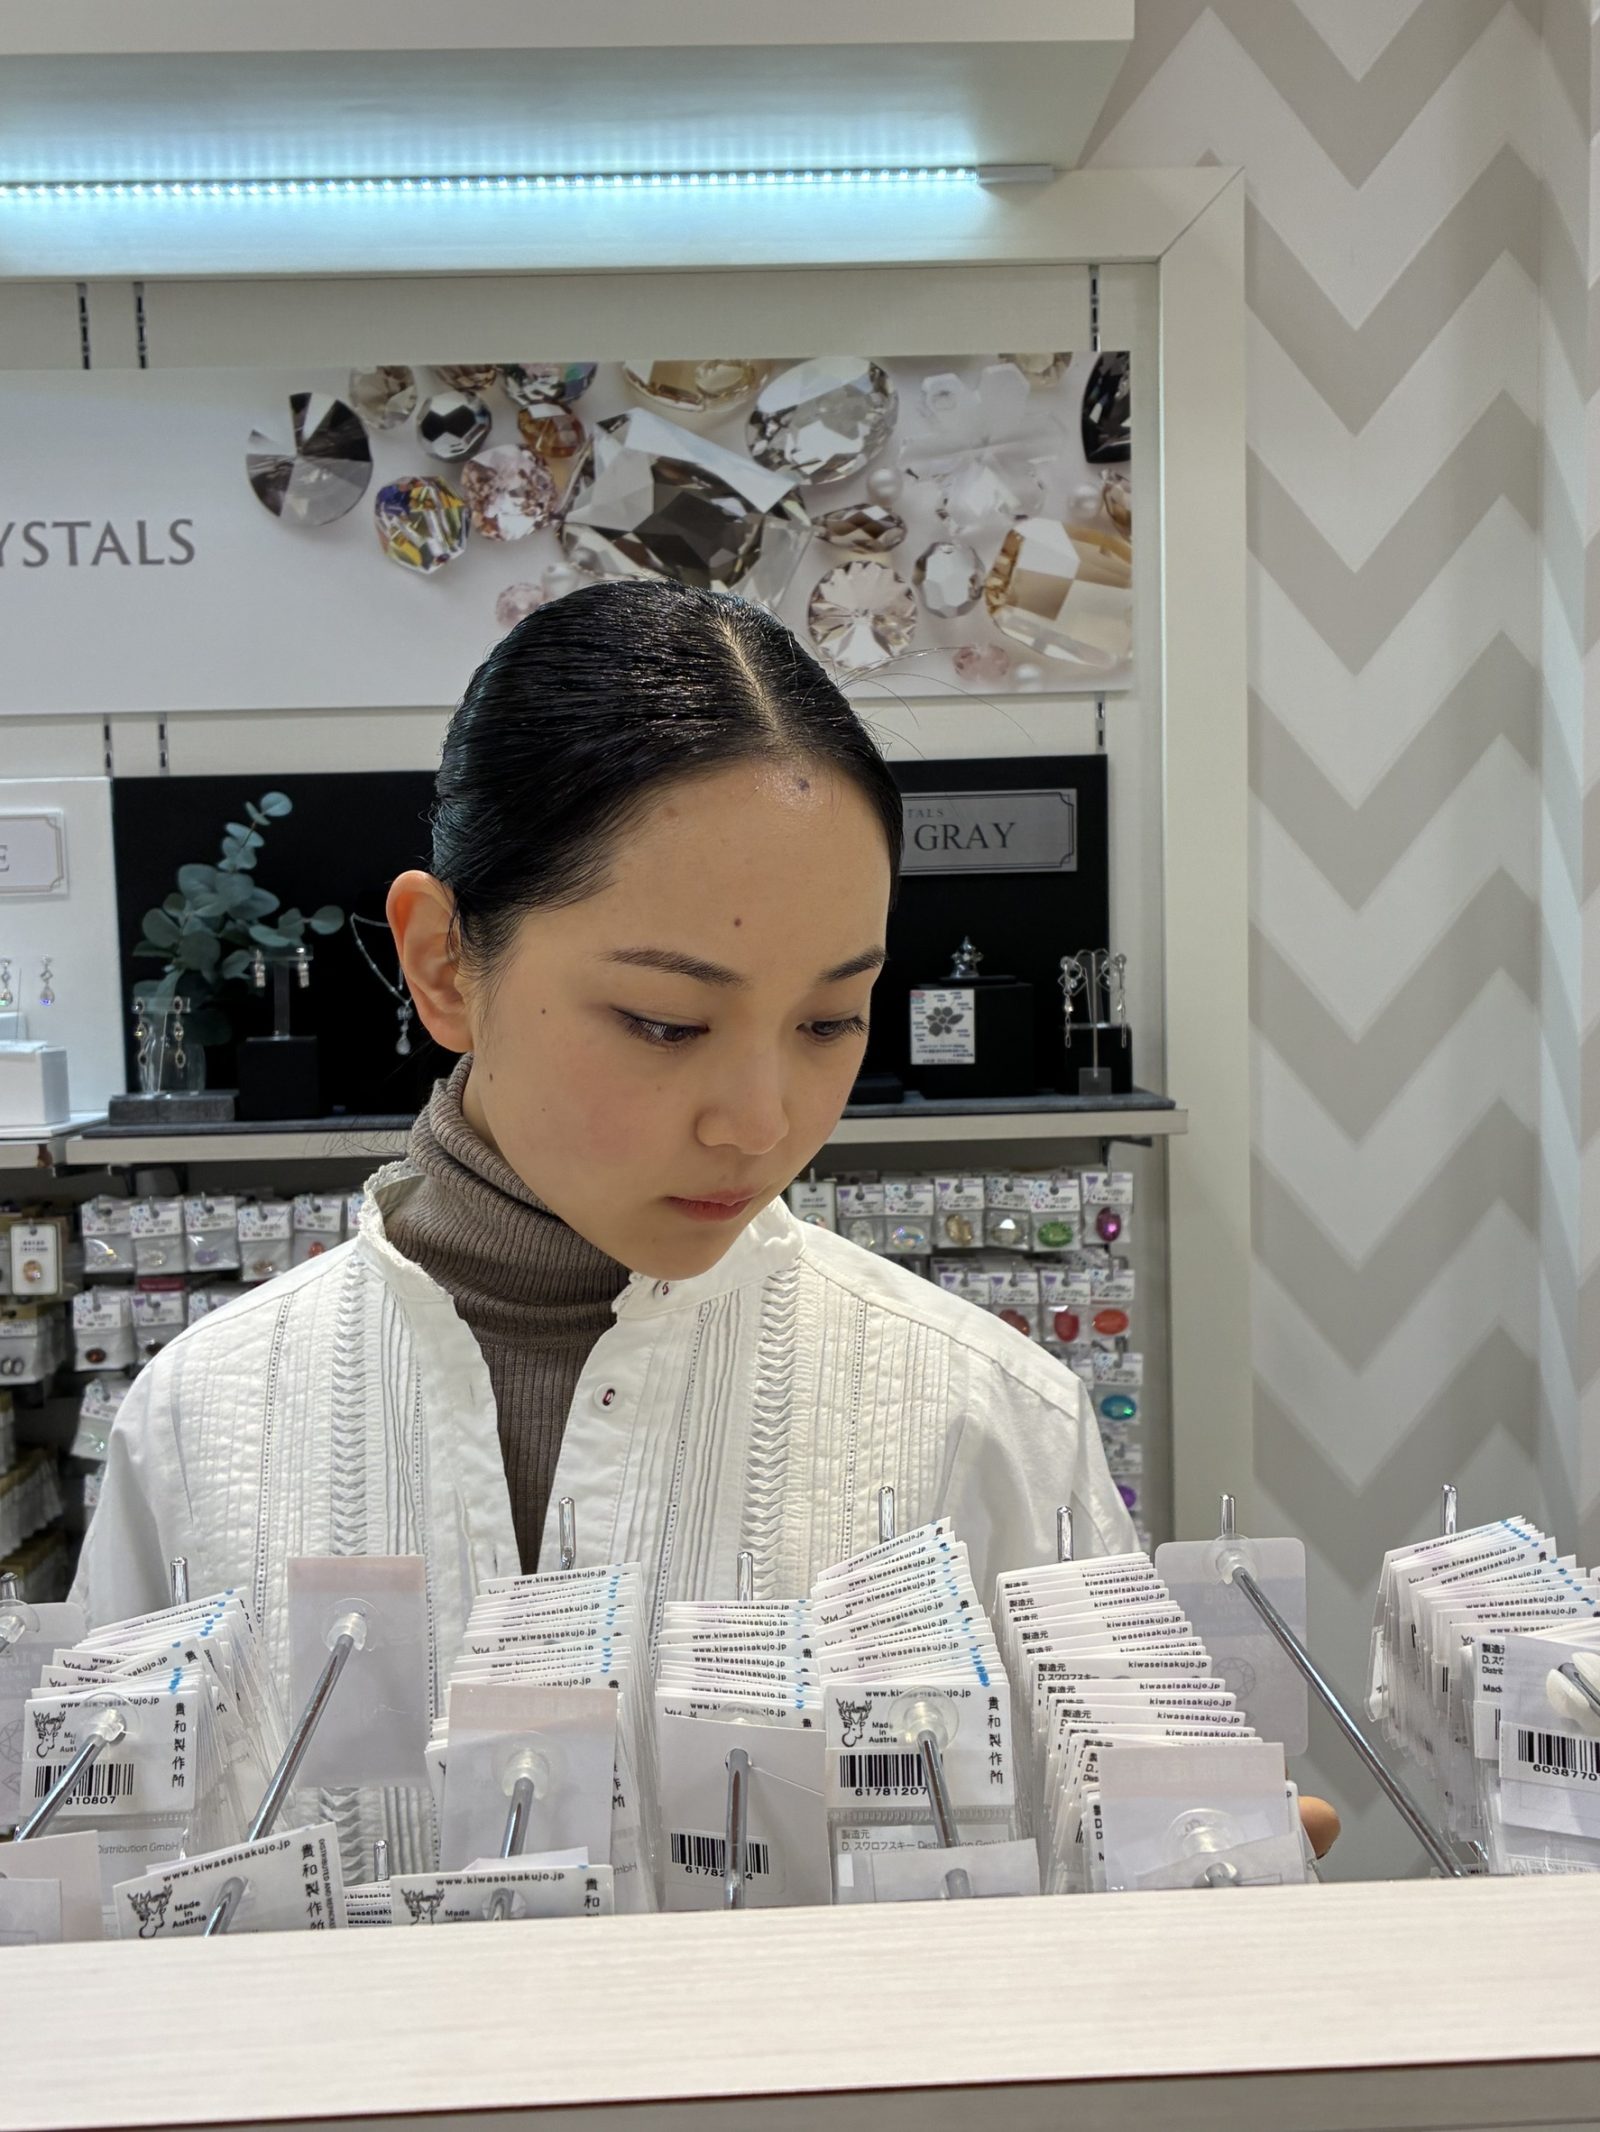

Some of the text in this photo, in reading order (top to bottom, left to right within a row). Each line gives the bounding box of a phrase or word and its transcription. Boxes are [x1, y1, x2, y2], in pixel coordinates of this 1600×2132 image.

[914, 821, 1016, 851] GRAY
[848, 1529, 925, 1568] www.kiwaseisakujo.jp
[848, 1555, 937, 1587] www.kiwaseisakujo.jp
[1441, 1552, 1526, 1585] www.kiwaseisakujo.jp
[513, 1568, 607, 1587] www.kiwaseisakujo.jp
[1085, 1572, 1154, 1587] kiwaseisakujo.jp
[845, 1577, 937, 1609] www.kiwaseisakujo.jp
[1094, 1591, 1166, 1609] kiwaseisakujo.jp
[1009, 1597, 1035, 1608] 製造元
[1465, 1594, 1565, 1609] www.kiwaseisakujo.jp
[849, 1600, 944, 1634] www.kiwaseisakujo.jp
[1477, 1606, 1578, 1620] www.kiwaseisakujo.jp
[1106, 1614, 1182, 1629] kiwaseisakujo.jp
[498, 1627, 597, 1644] www.kiwaseisakujo.jp
[692, 1629, 786, 1640] www.kiwaseisakujo.jp
[1022, 1630, 1049, 1641] 製造元
[1112, 1625, 1189, 1642] kiwaseisakujo.jp
[692, 1642, 788, 1654] www.kiwaseisakujo.jp
[857, 1641, 959, 1663] www.kiwaseisakujo.jp
[694, 1655, 786, 1668] www.kiwaseisakujo.jp
[1038, 1663, 1067, 1672] 製造元
[1128, 1660, 1208, 1669] kiwaseisakujo.jp
[1047, 1685, 1077, 1694] 製造元
[1139, 1681, 1221, 1691] kiwaseisakujo.jp
[1149, 1697, 1232, 1708] kiwaseisakujo.jp
[1061, 1708, 1092, 1720] 製造元
[1157, 1711, 1241, 1724] kiwaseisakujo.jp
[868, 1735, 898, 1744] Austria
[878, 1729, 887, 1737] in
[171, 1702, 187, 1788] 貴和製作所
[987, 1696, 1004, 1785] 貴和製作所
[855, 1786, 928, 1797] 61781207
[65, 1795, 117, 1806] 810807
[841, 1829, 871, 1841] 製造元
[854, 1840, 916, 1852] スワロフスキー
[162, 1838, 292, 1883] www.kiwaseisakujo.jp
[613, 1861, 638, 1876] mbH
[684, 1865, 754, 1881] 617824
[436, 1872, 565, 1886] www.kiwaseisakujo.jp
[174, 1901, 202, 1913] Made
[183, 1910, 193, 1918] in
[445, 1908, 471, 1918] Made
[171, 1914, 208, 1929] Austria
